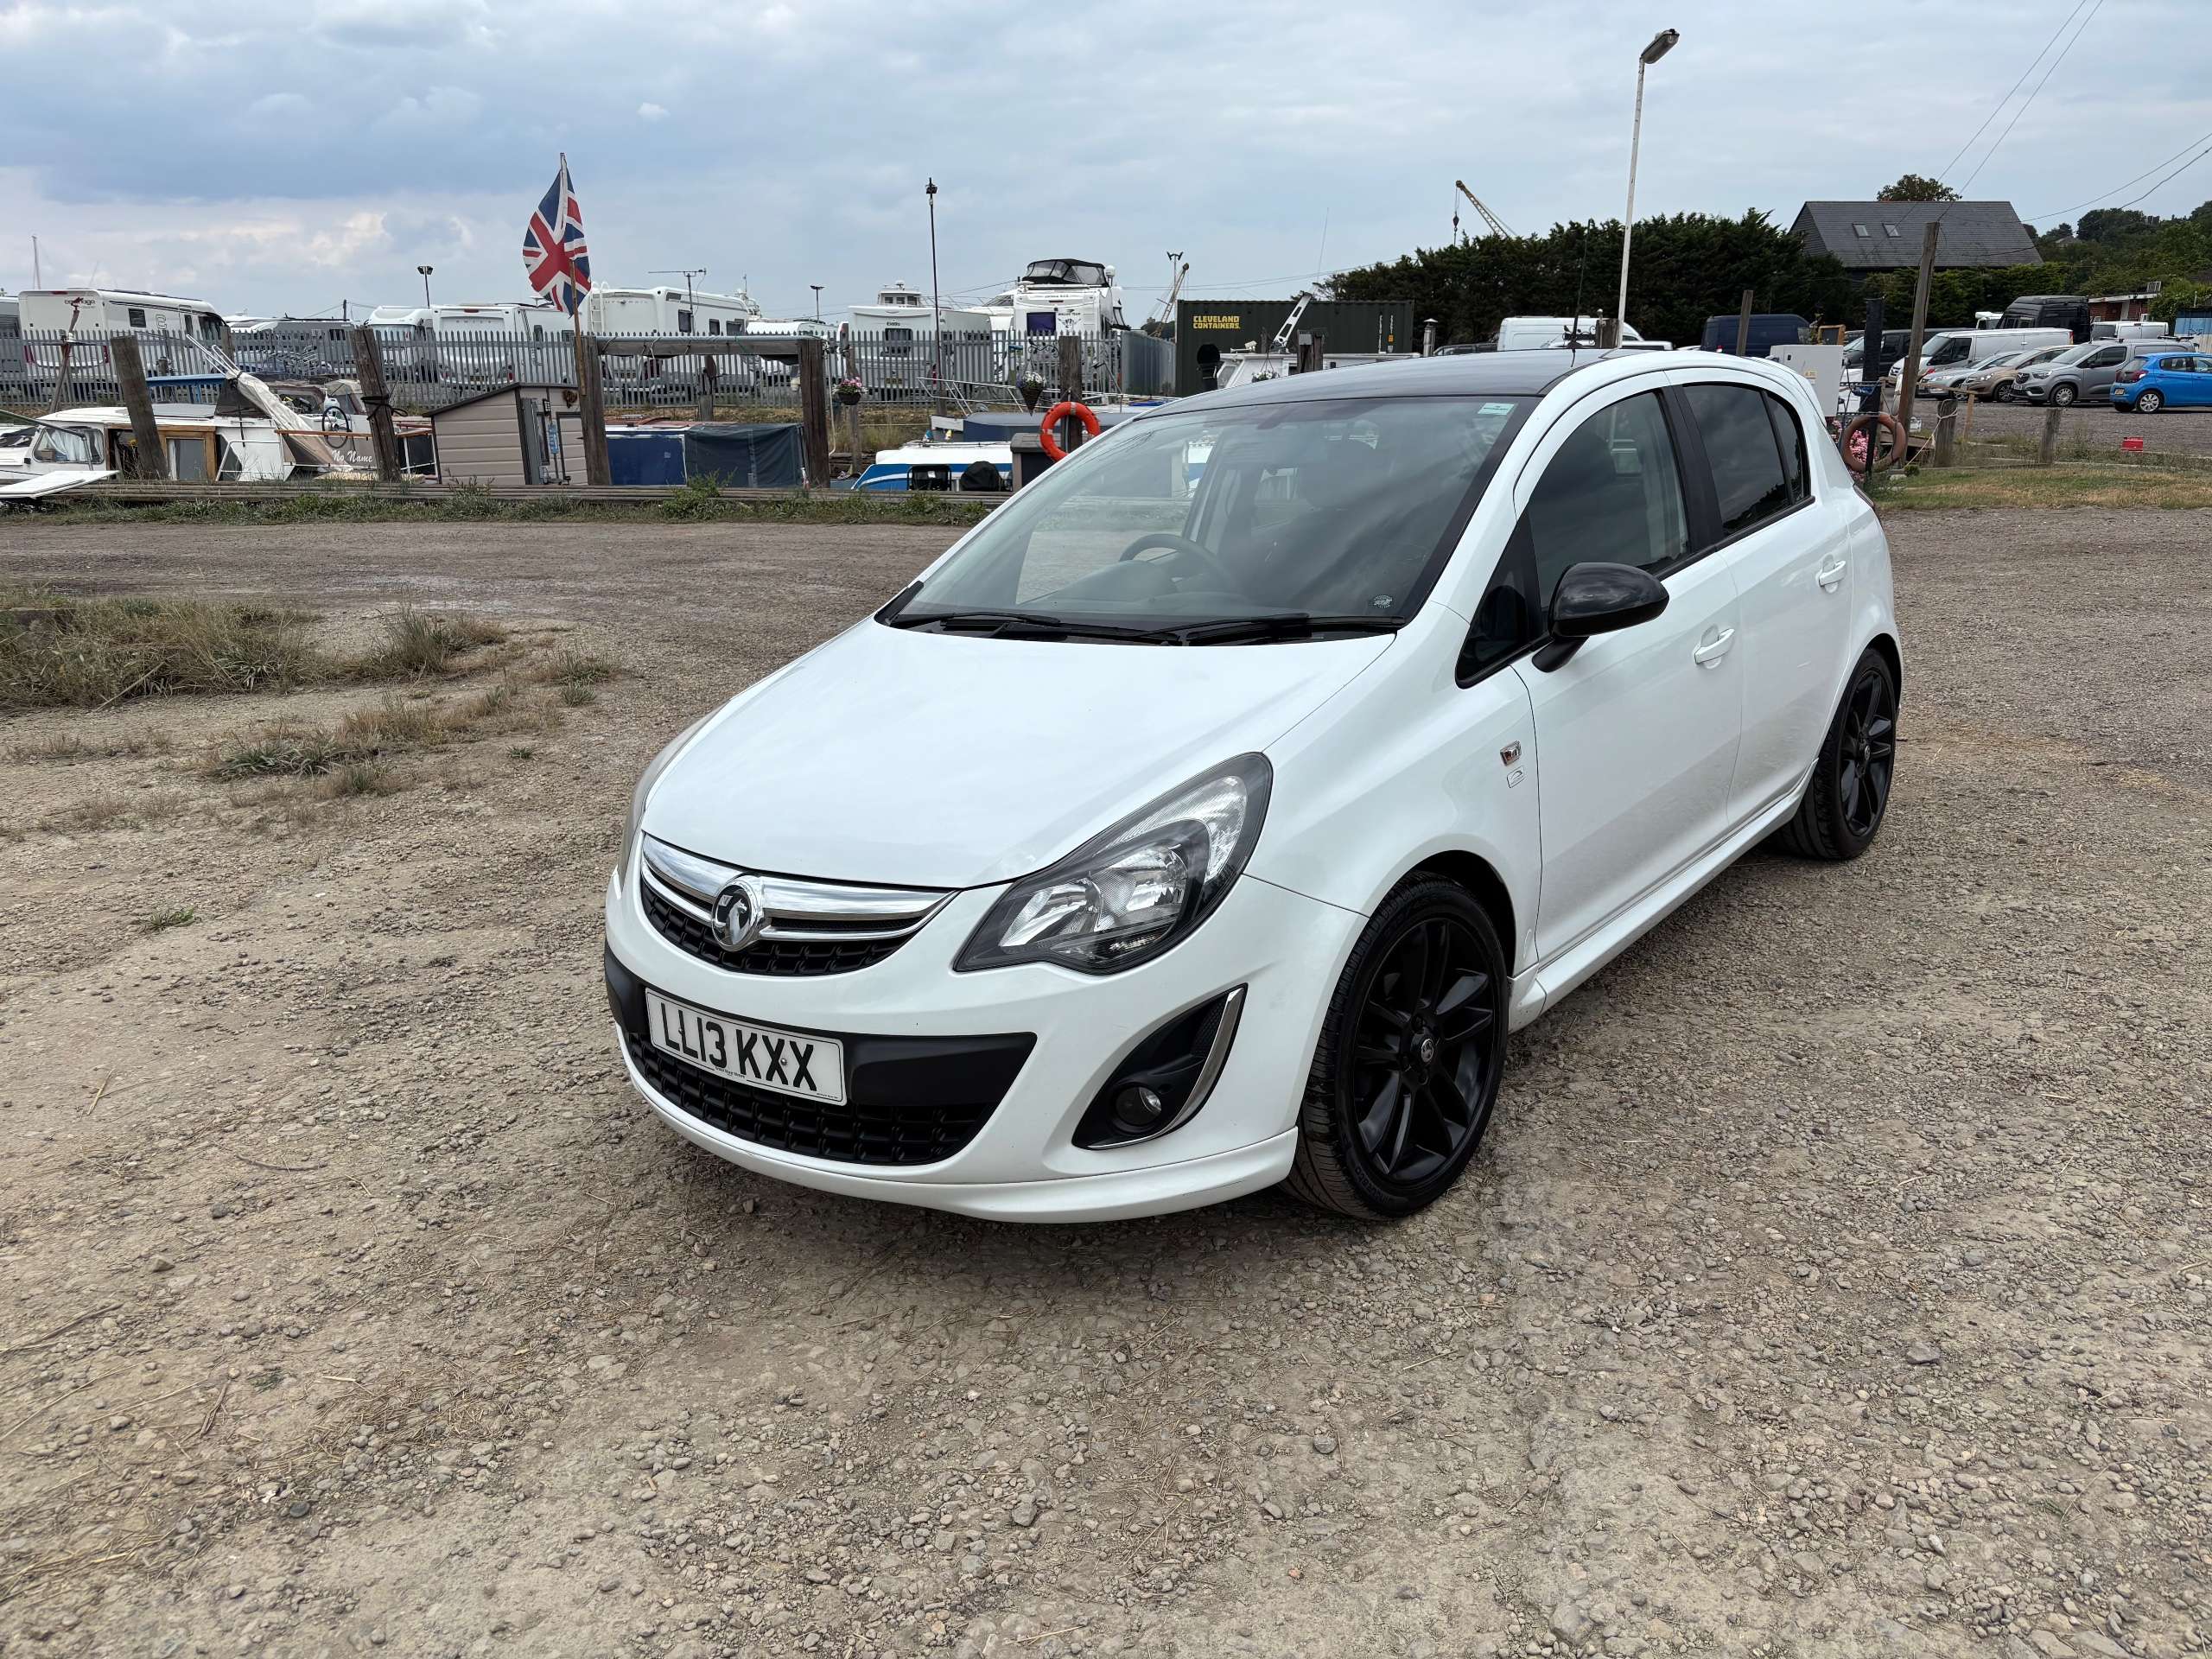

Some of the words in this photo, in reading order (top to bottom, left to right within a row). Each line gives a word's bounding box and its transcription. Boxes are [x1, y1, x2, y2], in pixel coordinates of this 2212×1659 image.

[331, 449, 345, 462] No
[346, 449, 373, 463] Name
[660, 1002, 728, 1069] LL13
[735, 1028, 817, 1092] KXX
